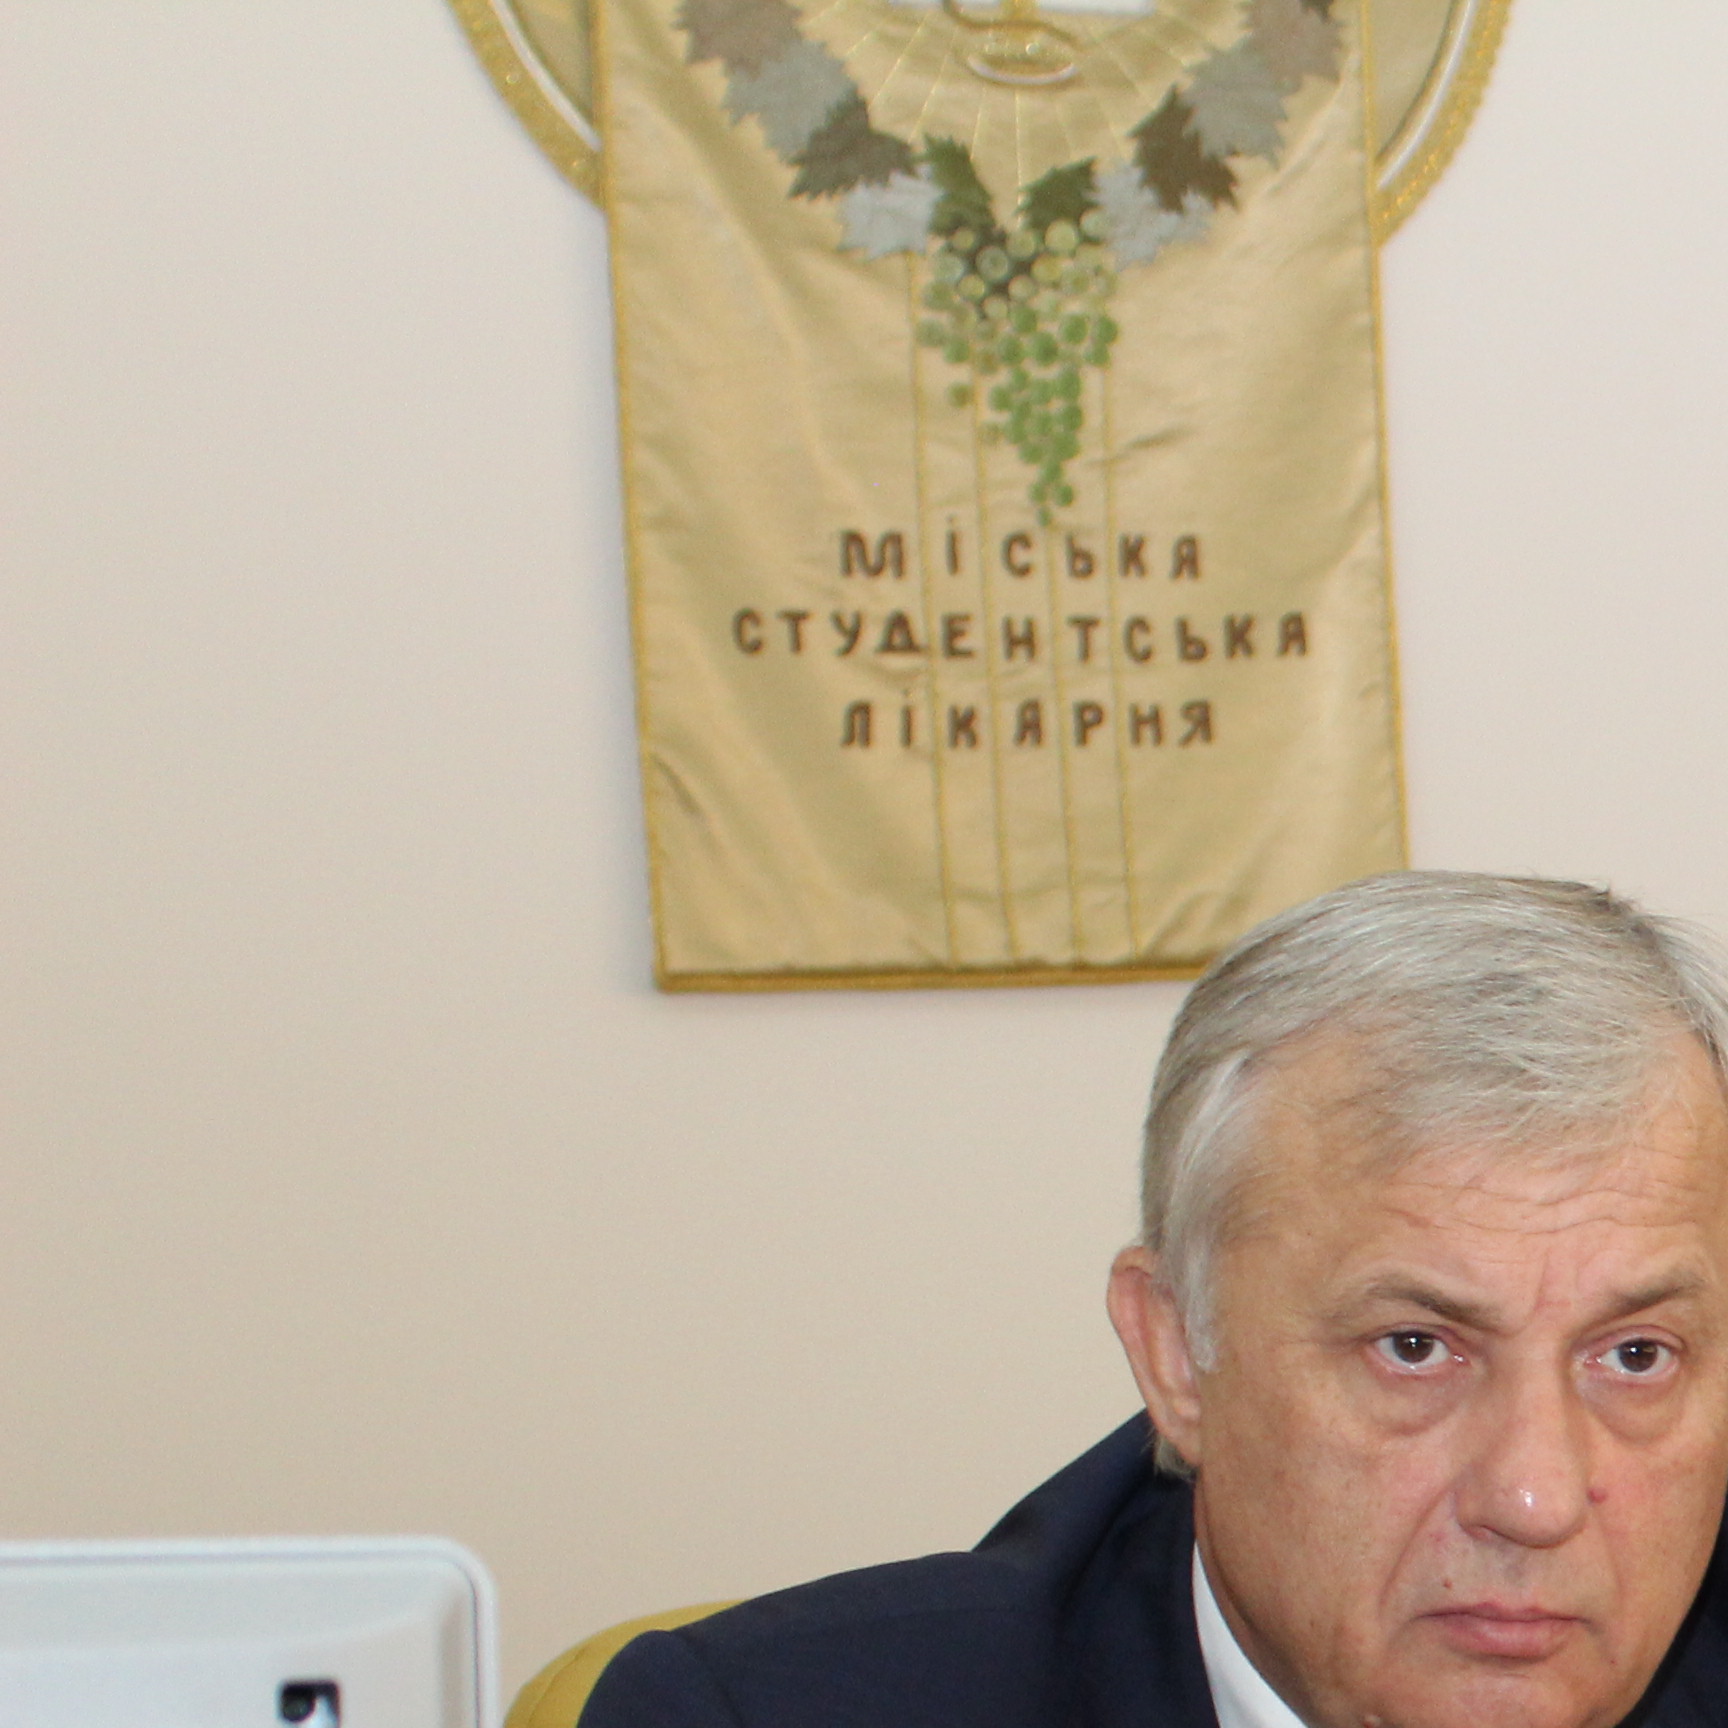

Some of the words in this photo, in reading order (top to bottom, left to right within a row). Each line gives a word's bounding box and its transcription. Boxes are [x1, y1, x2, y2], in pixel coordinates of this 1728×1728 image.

[839, 515, 1203, 579] МІСЬКА
[731, 609, 1310, 663] СТУДЕНТСЬКА
[840, 690, 1217, 749] ЛІКАРНЯ
